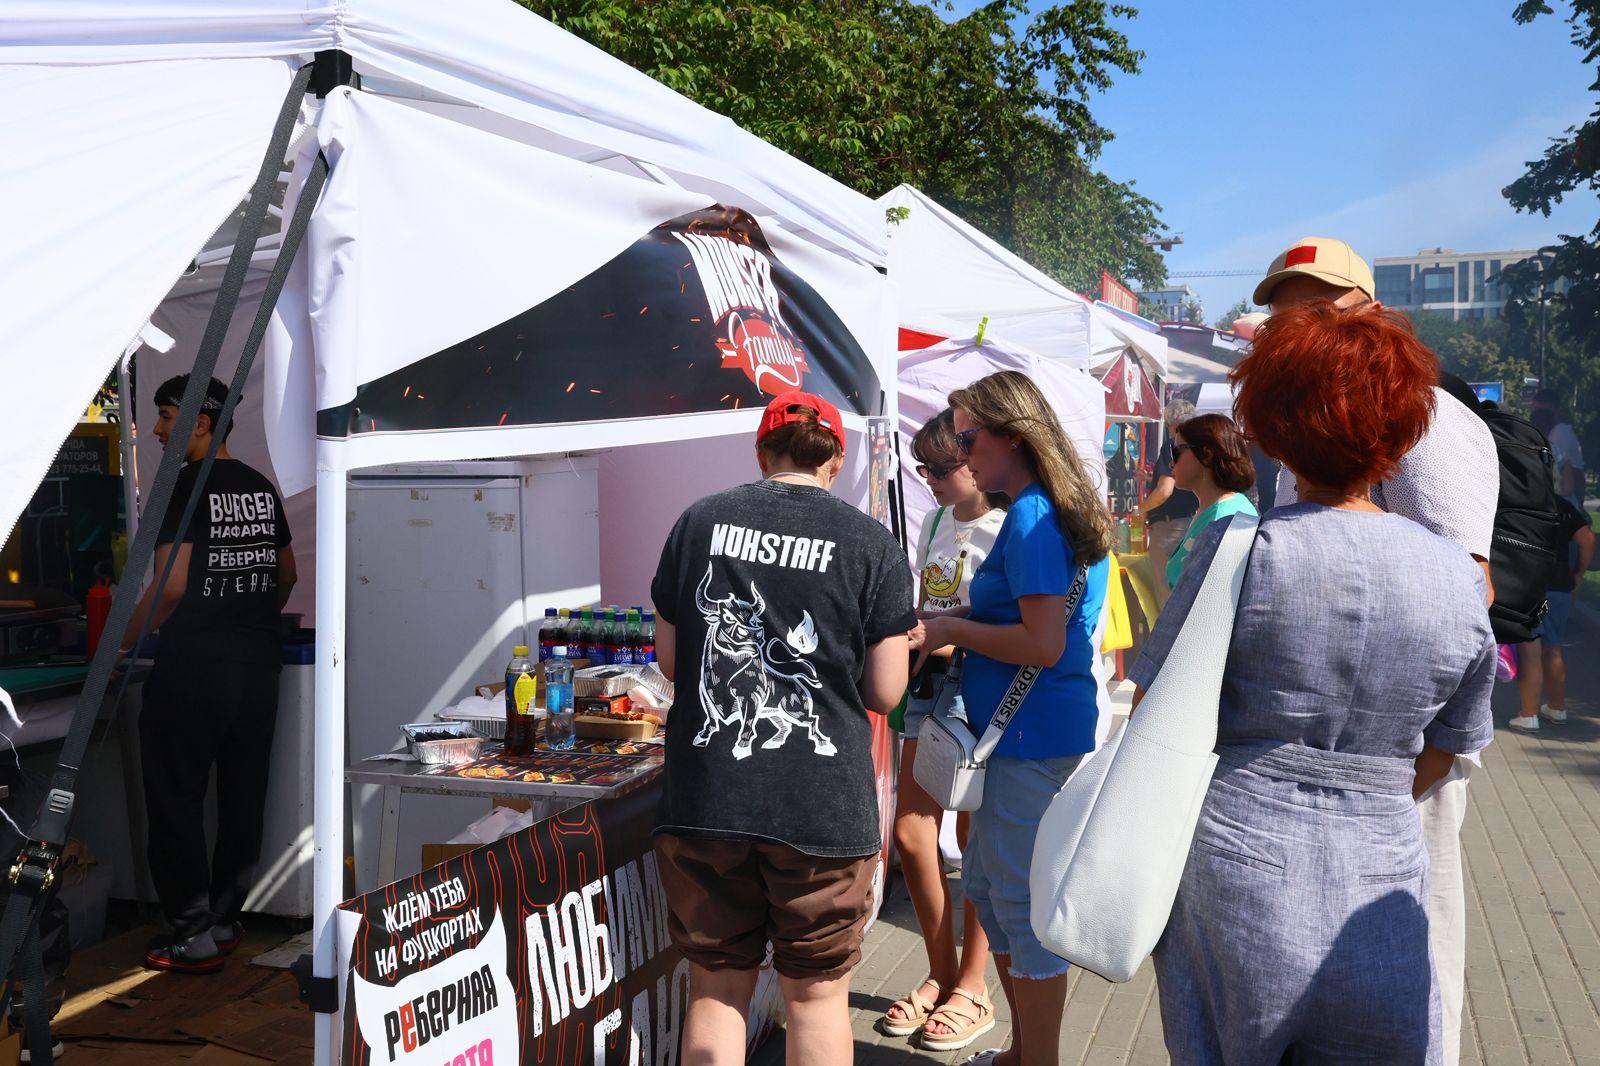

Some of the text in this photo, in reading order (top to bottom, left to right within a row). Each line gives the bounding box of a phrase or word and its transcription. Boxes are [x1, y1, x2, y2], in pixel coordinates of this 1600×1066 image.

[209, 492, 275, 522] BURGER
[382, 876, 466, 933] ЖДЁМ ТЕБЯ
[375, 906, 484, 978] НА ФУДКОРТАХ
